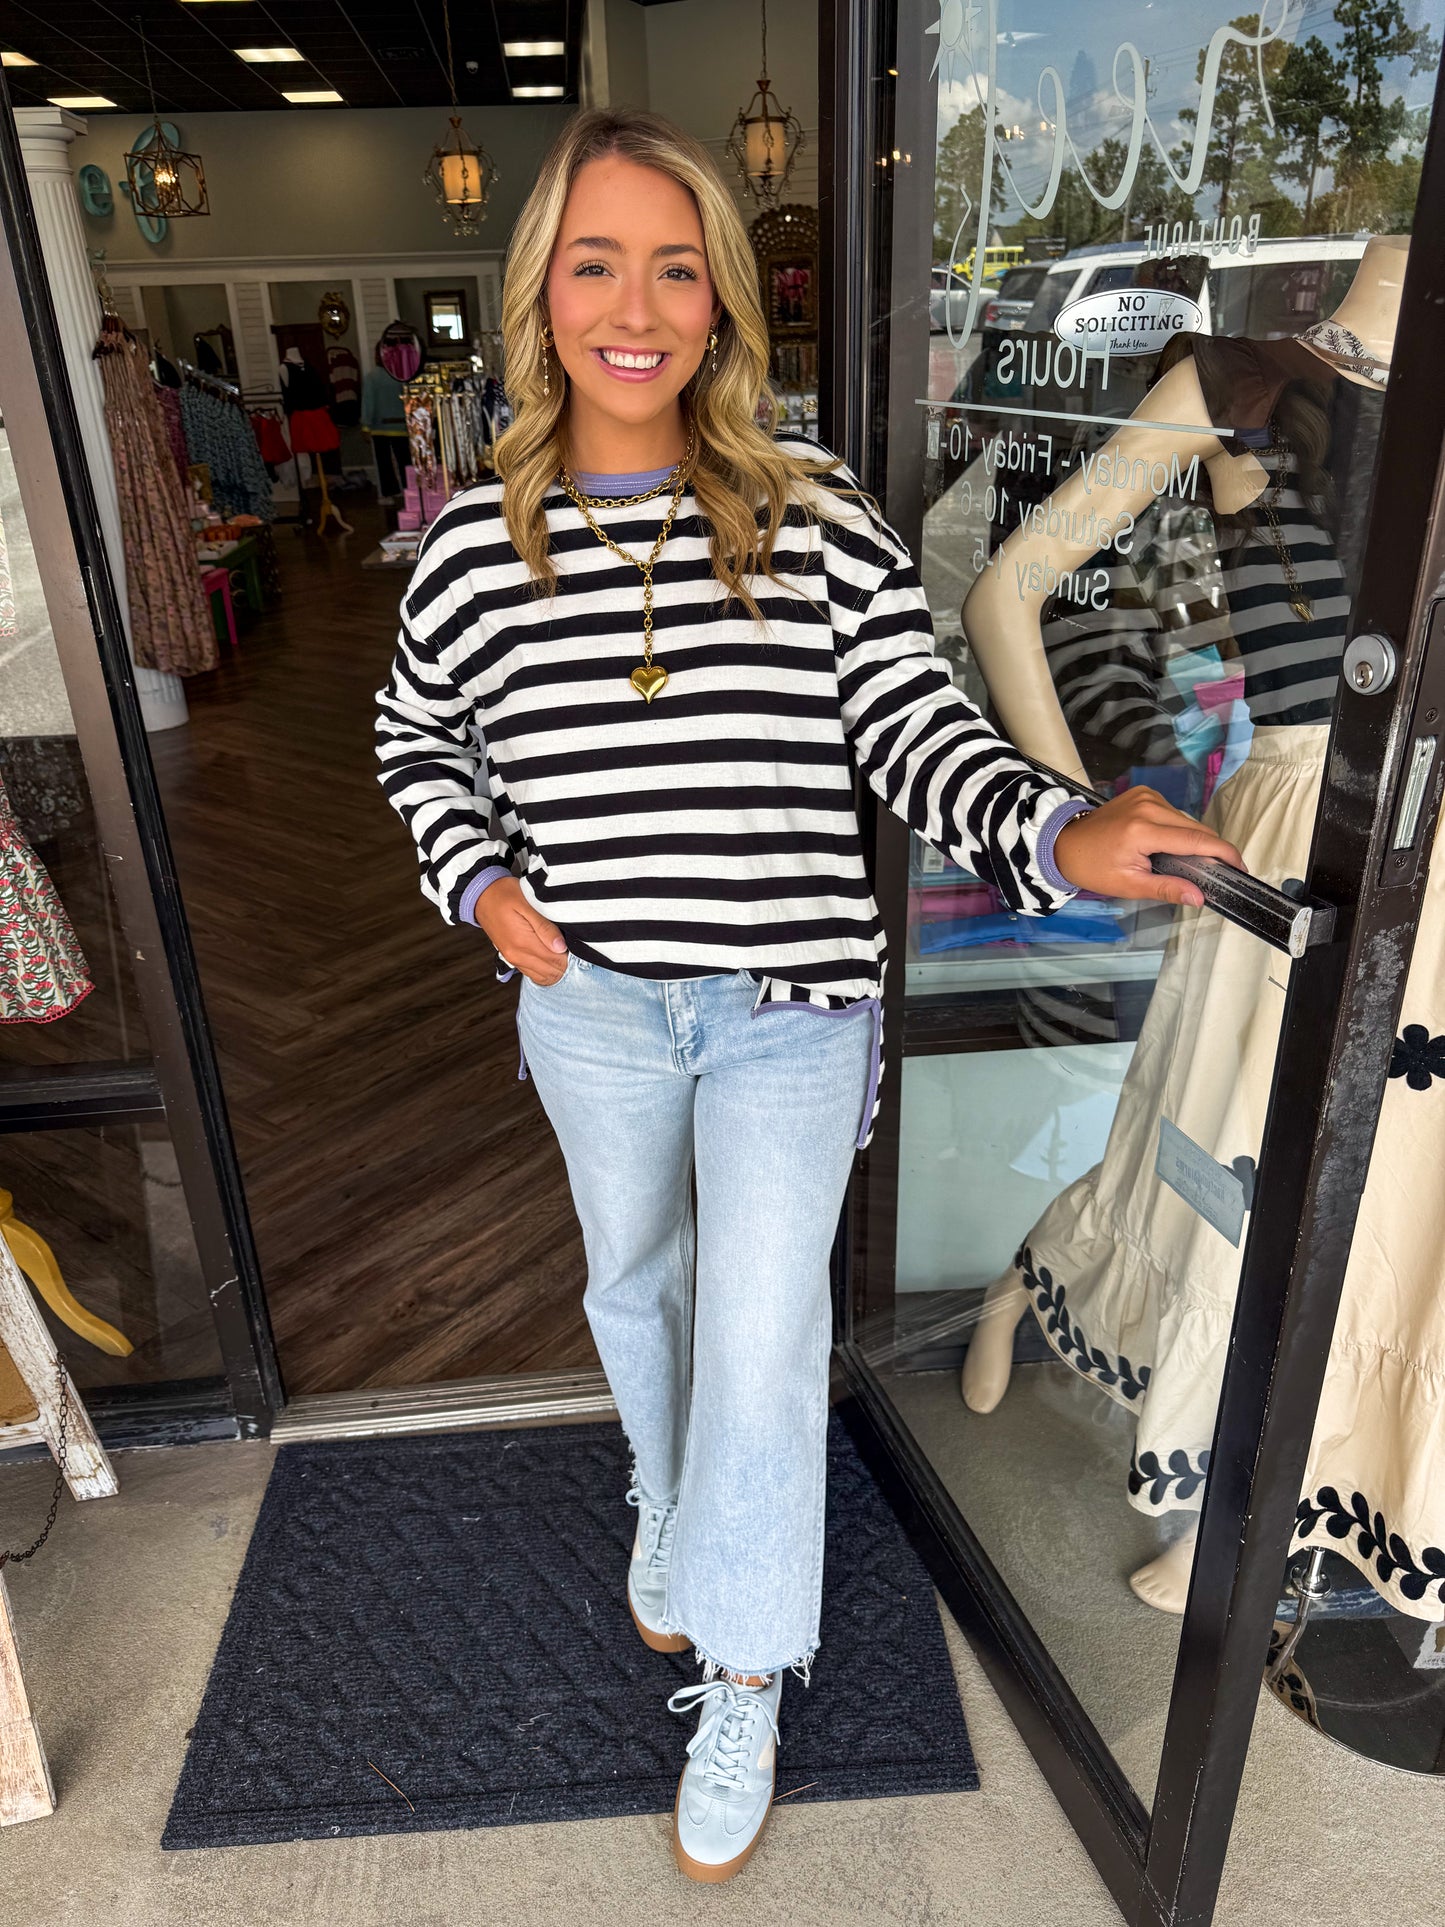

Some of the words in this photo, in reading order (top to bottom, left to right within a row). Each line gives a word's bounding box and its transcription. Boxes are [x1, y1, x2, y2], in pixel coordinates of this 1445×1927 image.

[1117, 296, 1146, 312] NO
[1075, 314, 1184, 334] SOLICITING
[1109, 339, 1132, 350] Thank
[1133, 338, 1149, 350] You
